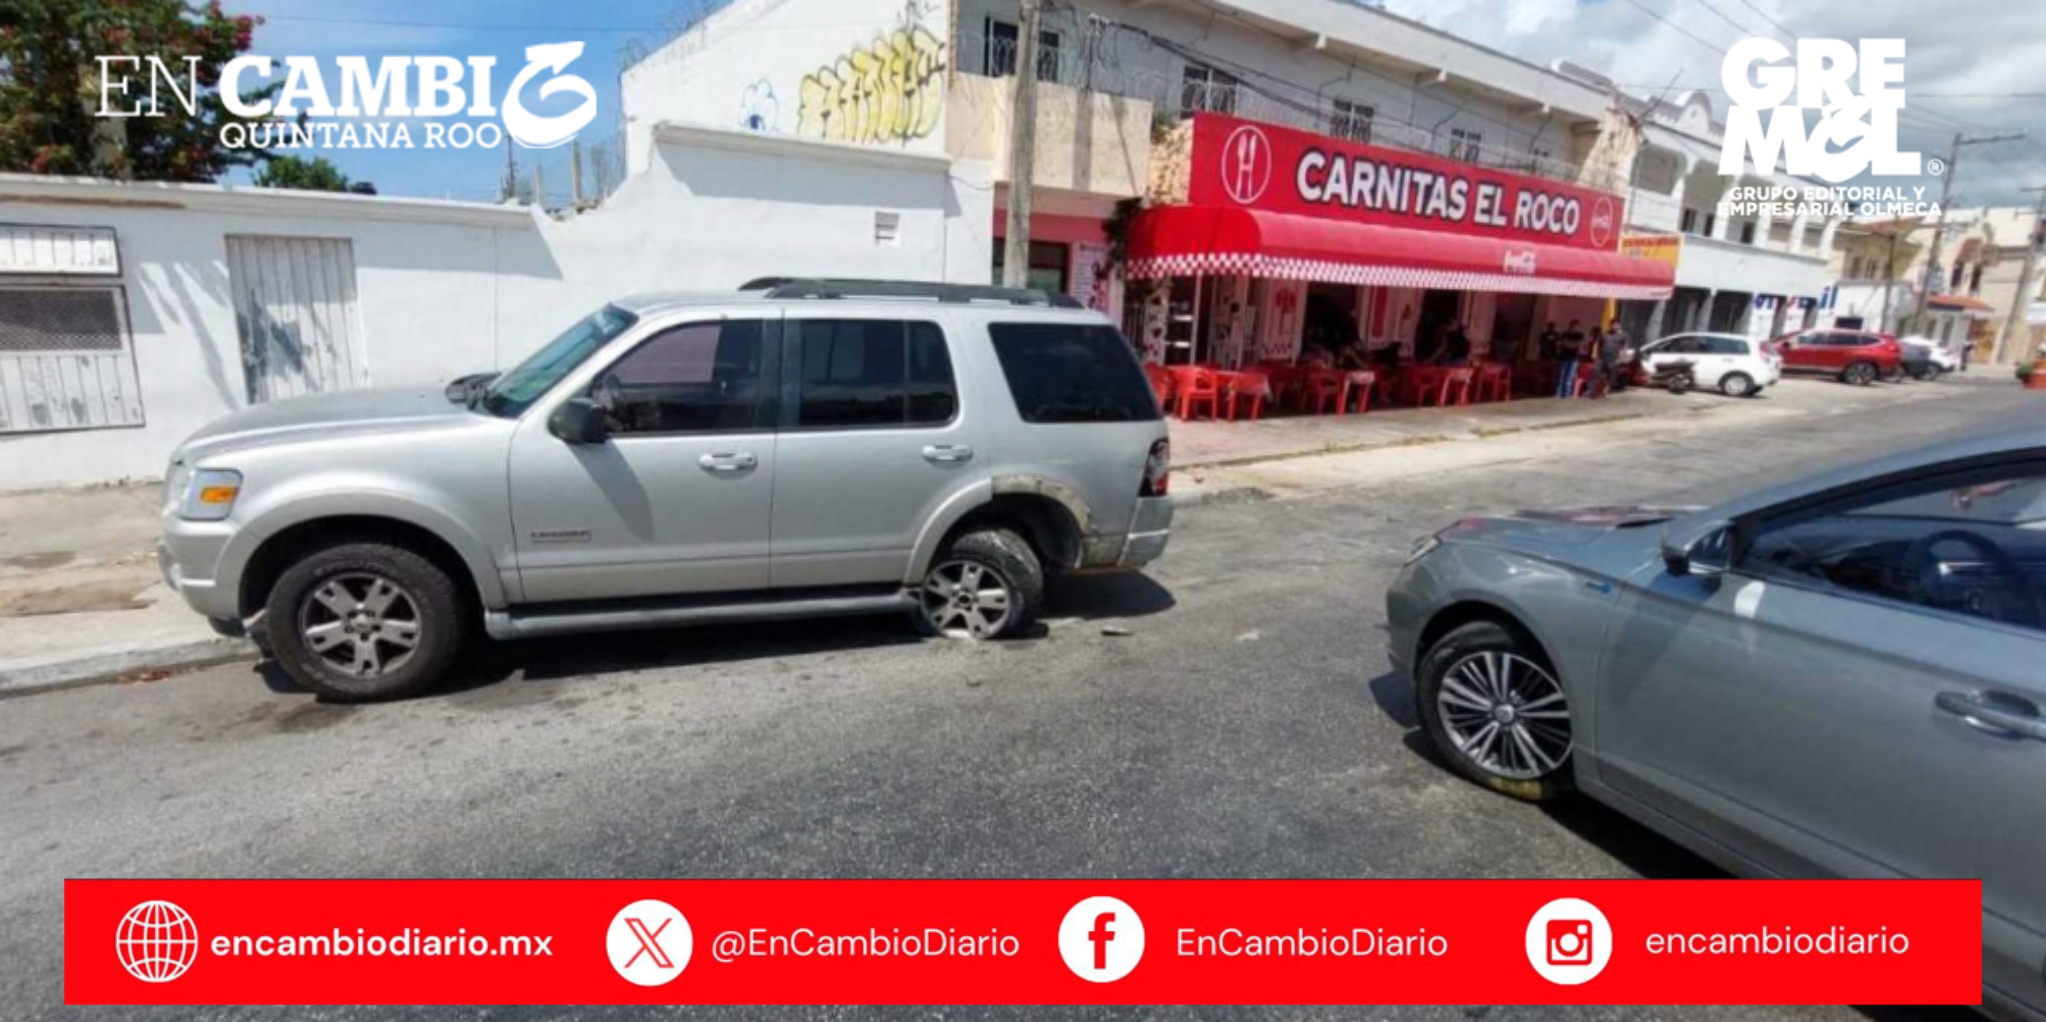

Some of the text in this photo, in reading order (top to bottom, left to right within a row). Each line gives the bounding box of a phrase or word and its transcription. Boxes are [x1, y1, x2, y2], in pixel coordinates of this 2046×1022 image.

[1297, 150, 1581, 235] CARNITAS EL ROCO
